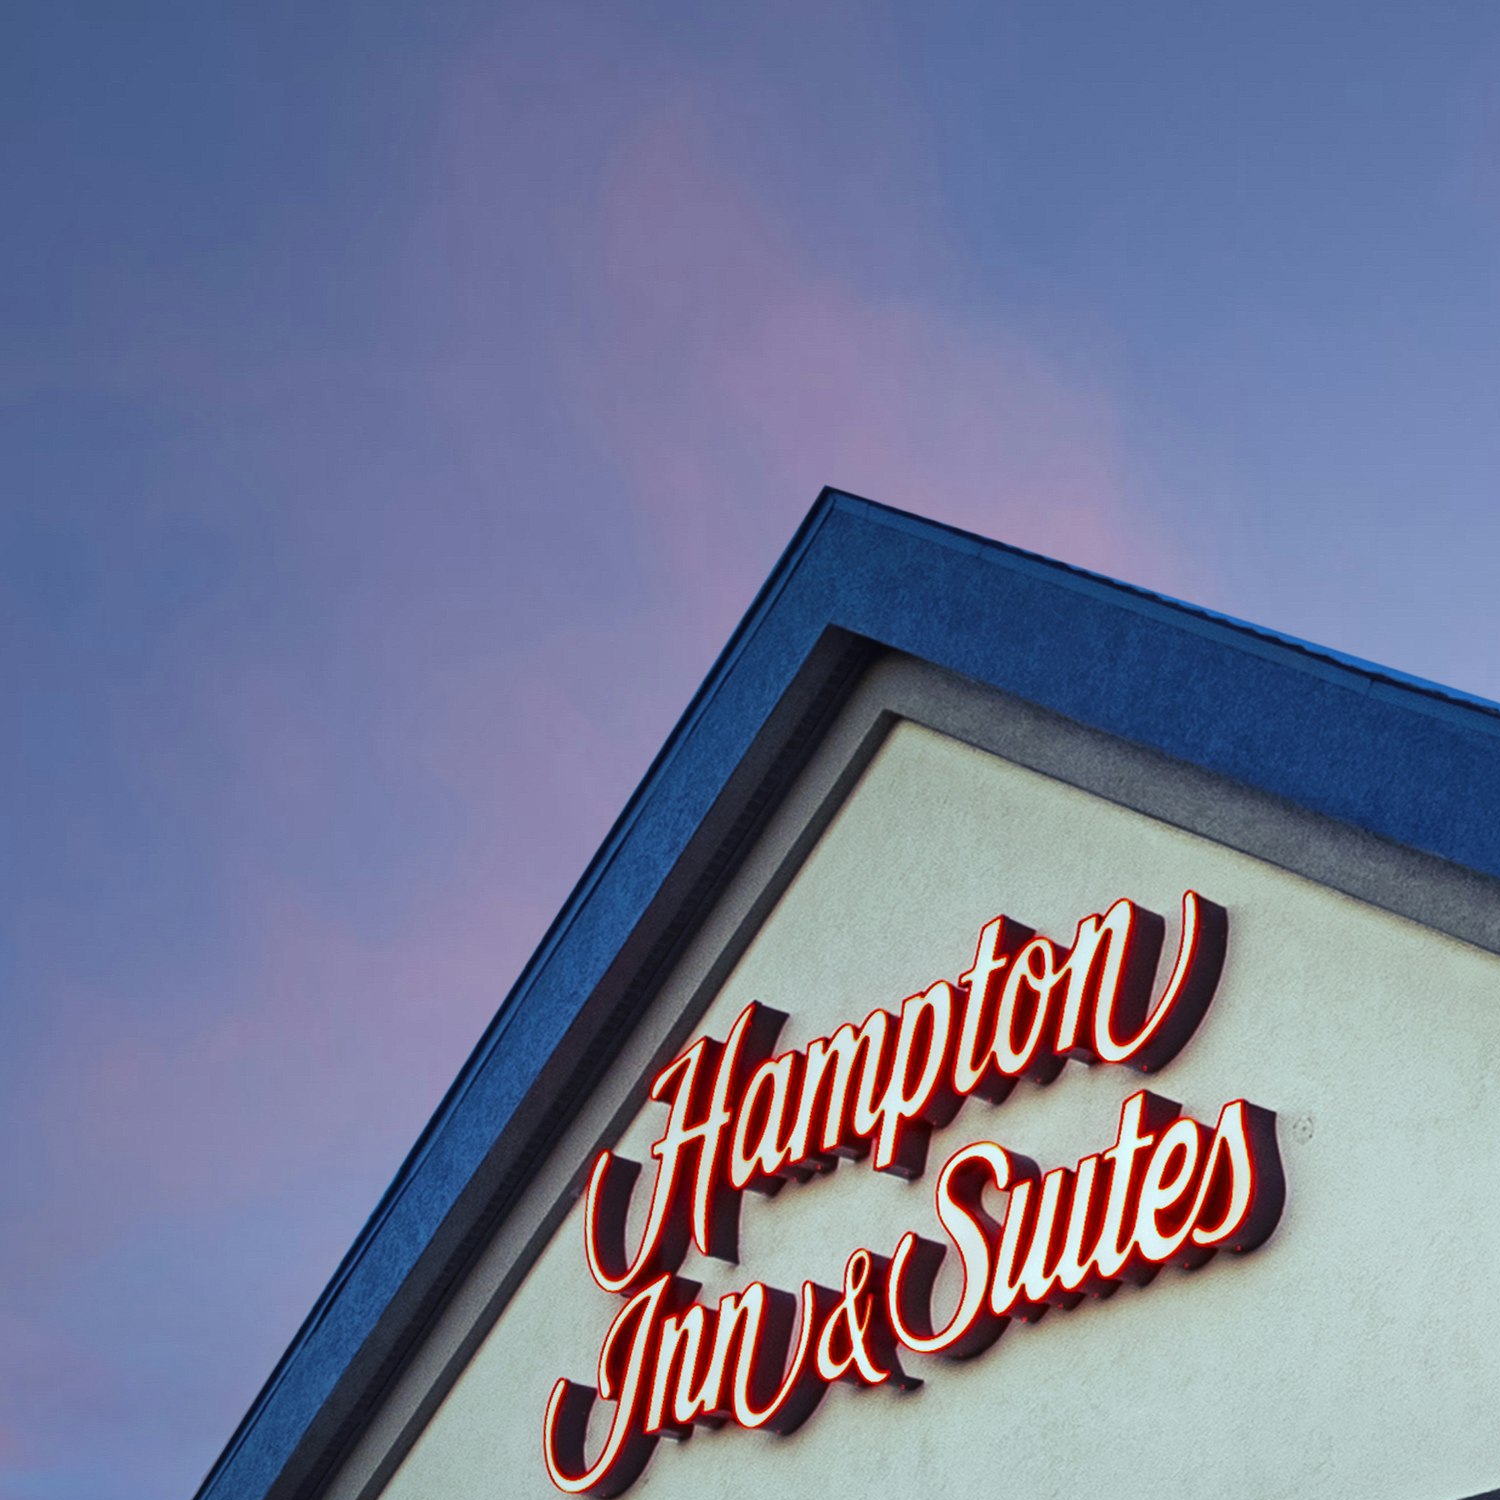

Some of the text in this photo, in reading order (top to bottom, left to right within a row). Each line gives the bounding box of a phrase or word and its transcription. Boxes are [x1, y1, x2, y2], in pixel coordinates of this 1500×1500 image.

[543, 1088, 1280, 1497] Inn & Suites
[583, 889, 1222, 1294] Hampton
